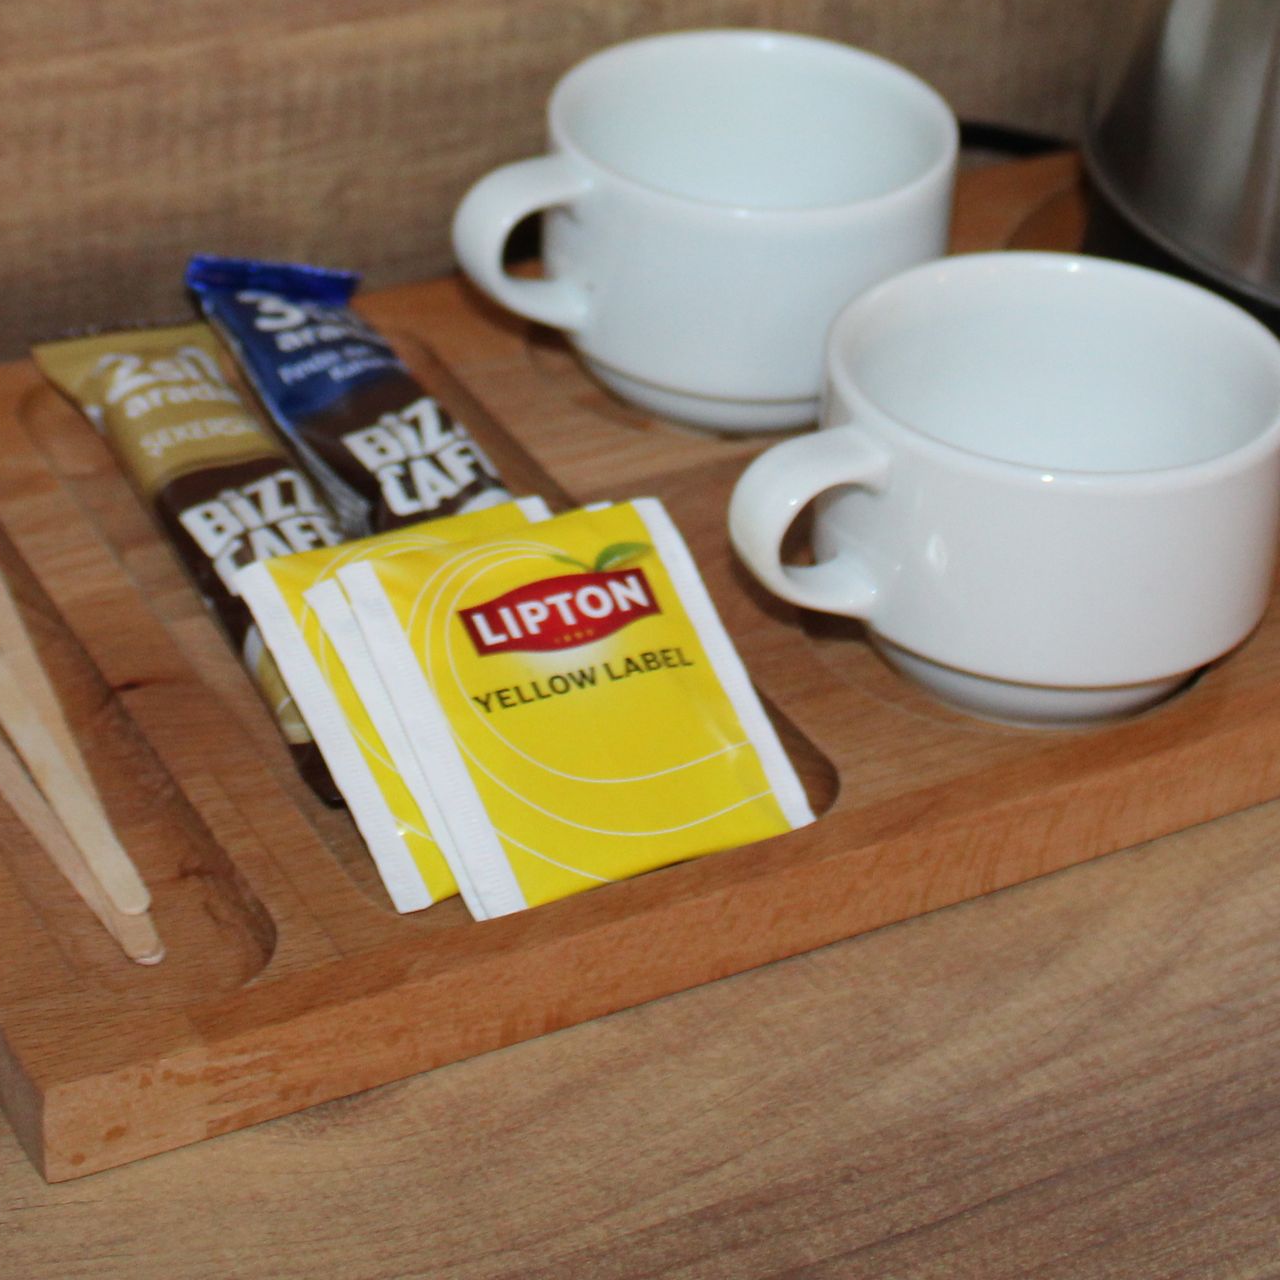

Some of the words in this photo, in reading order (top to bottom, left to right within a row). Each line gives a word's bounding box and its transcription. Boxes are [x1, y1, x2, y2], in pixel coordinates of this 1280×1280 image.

[471, 575, 651, 646] LIPTON
[473, 666, 597, 713] YELLOW
[603, 647, 696, 681] LABEL
